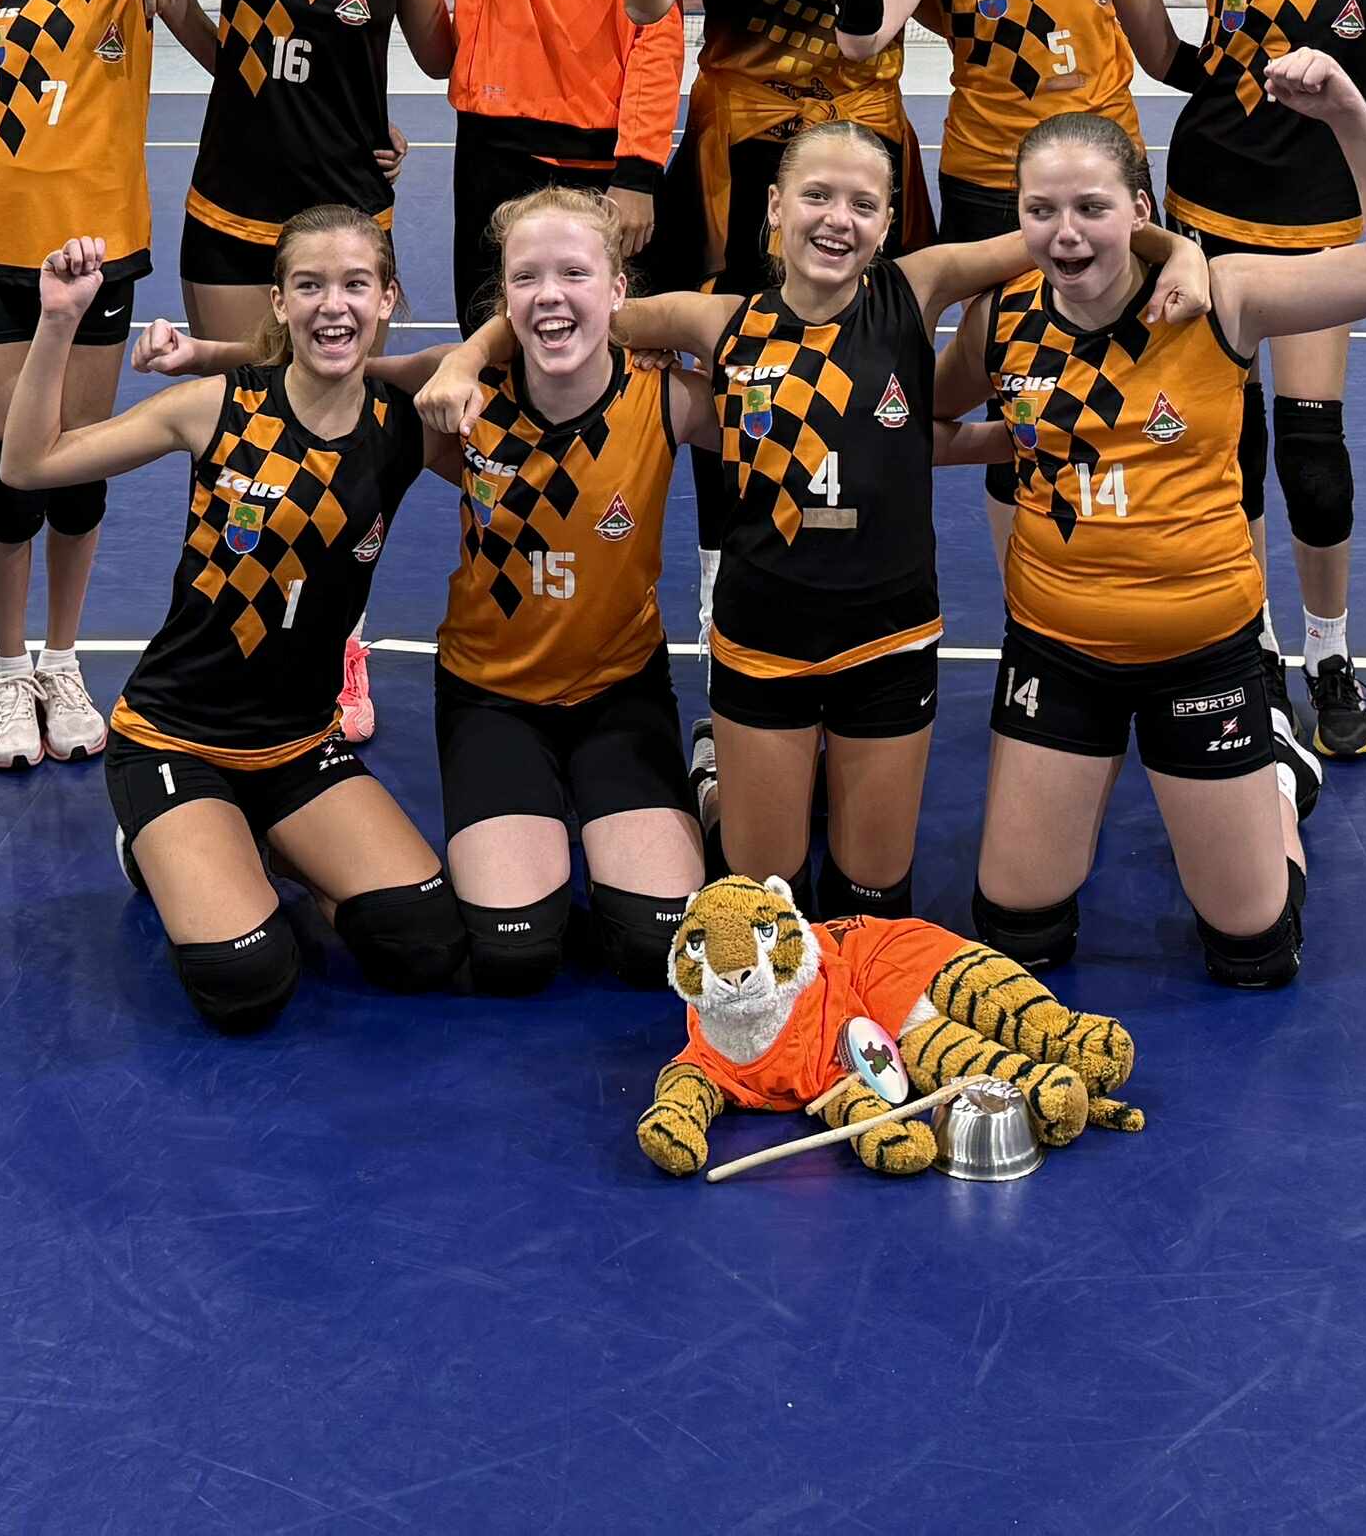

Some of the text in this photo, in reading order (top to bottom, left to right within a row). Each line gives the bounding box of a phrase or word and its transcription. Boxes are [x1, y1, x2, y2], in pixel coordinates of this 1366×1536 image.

[272, 36, 312, 84] 16
[1046, 29, 1077, 75] 5
[40, 80, 67, 126] 7
[807, 450, 841, 506] 4
[1075, 462, 1128, 517] 14
[529, 550, 576, 600] 15
[281, 579, 304, 629] 1
[1005, 667, 1040, 718] 14
[158, 763, 176, 795] 1
[851, 884, 882, 898] KIPSTA
[234, 930, 266, 950] KIPSTA
[498, 922, 531, 933] KIPSTA
